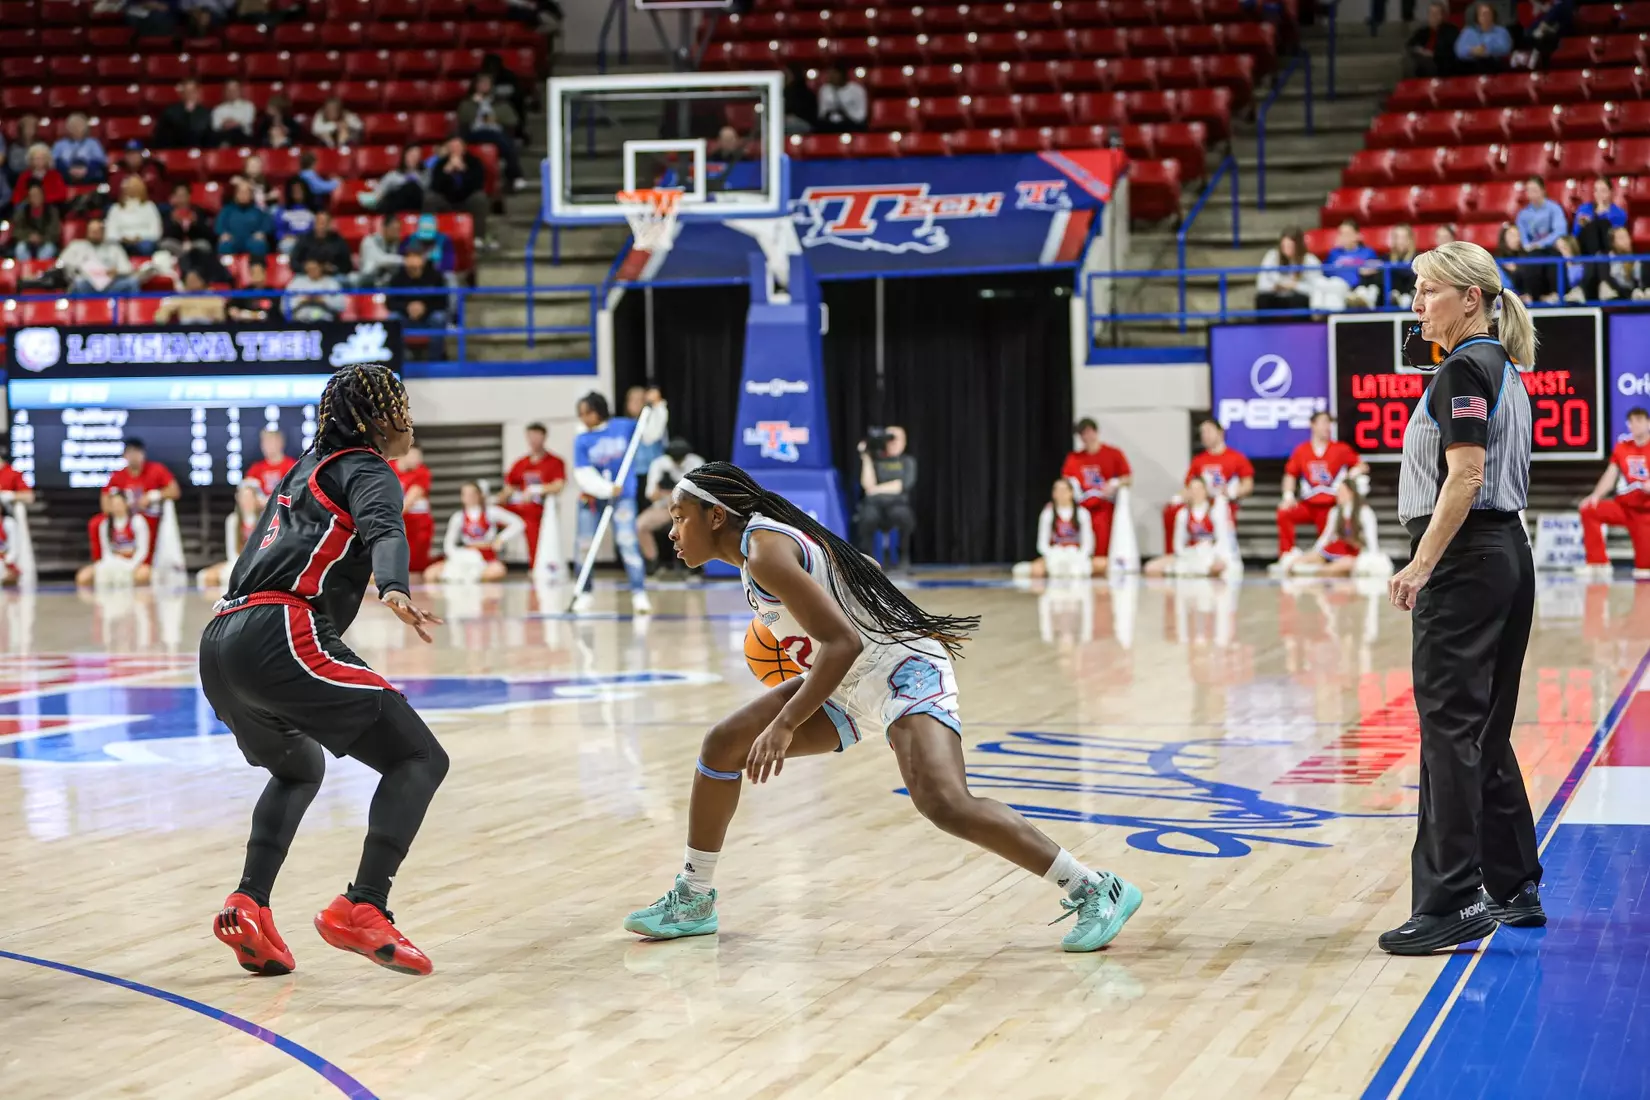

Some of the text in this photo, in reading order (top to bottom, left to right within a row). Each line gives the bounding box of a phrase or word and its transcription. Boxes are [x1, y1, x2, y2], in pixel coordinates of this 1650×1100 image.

[66, 330, 323, 364] LOUISIANA TECH
[1355, 402, 1409, 448] 28
[1534, 399, 1589, 447] 20
[1460, 901, 1486, 919] HOKA
